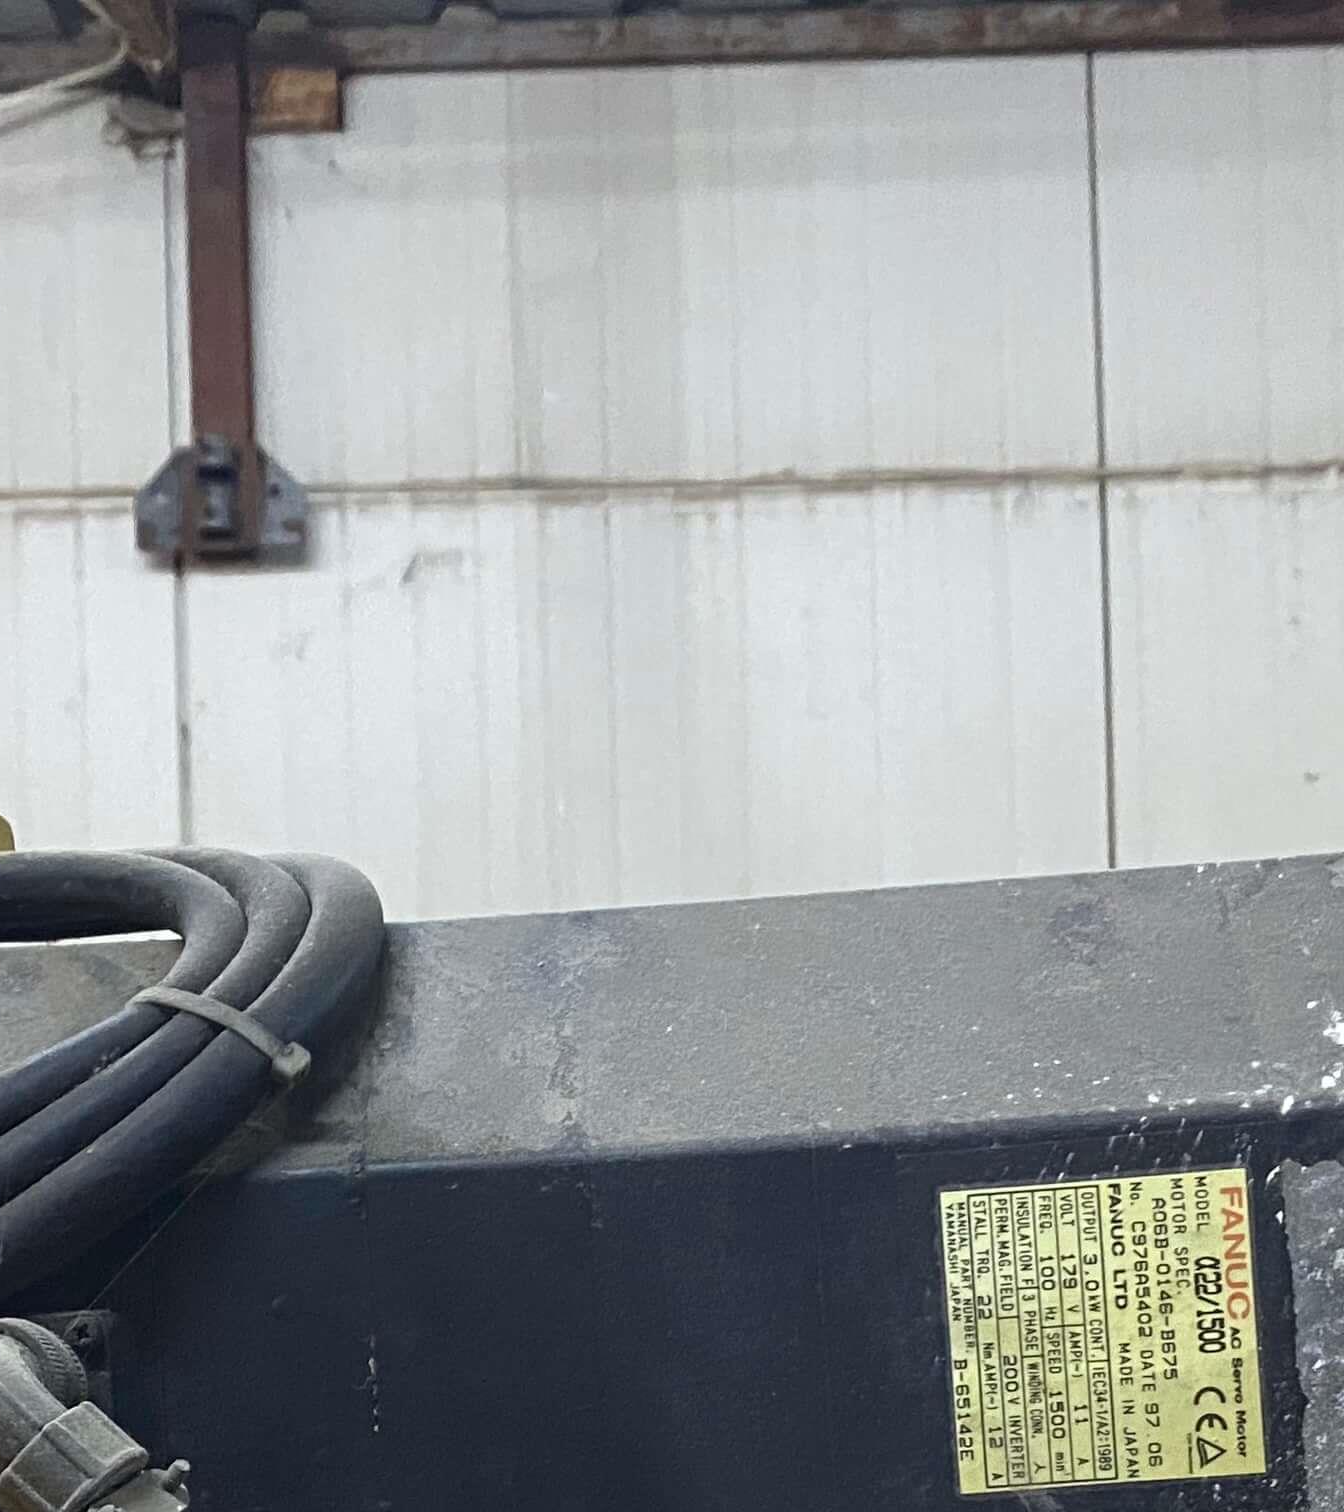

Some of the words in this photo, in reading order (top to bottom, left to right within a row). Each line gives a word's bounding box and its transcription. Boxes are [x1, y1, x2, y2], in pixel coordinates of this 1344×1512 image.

[1060, 1195, 1074, 1226] VOLT
[1130, 1182, 1142, 1206] No.
[1171, 1178, 1187, 1234] MOTOR
[1195, 1176, 1210, 1232] MODEL
[957, 1202, 968, 1250] MANUAL
[973, 1200, 988, 1239] STALL
[1016, 1197, 1032, 1271] INSULATION
[1038, 1196, 1052, 1234] FREQ.
[1081, 1192, 1096, 1242] OUTPUT
[1108, 1184, 1125, 1256] FANUC
[946, 1204, 958, 1274] YAMANASHI
[1220, 1187, 1251, 1320] FANUC
[960, 1260, 972, 1290] PART
[976, 1249, 990, 1278] TRQ.
[1040, 1256, 1056, 1290] 100
[1061, 1254, 1077, 1289] 179
[1084, 1254, 1100, 1291] 3.0
[1132, 1221, 1152, 1337] C976A5402
[1174, 1247, 1190, 1295] SPEC.
[950, 1284, 961, 1321] JAPAN
[977, 1295, 992, 1320] 22
[1068, 1304, 1080, 1313] V
[1088, 1296, 1100, 1312] kW
[1113, 1269, 1128, 1309] LTD
[1152, 1198, 1178, 1380] A06B-0146-B675
[1024, 1311, 1039, 1350] PHASE
[1045, 1306, 1056, 1321] Hz
[982, 1342, 994, 1359] Nm
[1047, 1333, 1062, 1374] SPEED
[1089, 1319, 1104, 1357] CONT.
[1230, 1327, 1242, 1349] AC
[1004, 1355, 1019, 1392] 200
[1028, 1362, 1043, 1404] WINDING
[1118, 1343, 1133, 1386] MADE
[1140, 1350, 1156, 1392] DATE
[1232, 1358, 1243, 1404] Servo
[954, 1360, 974, 1461] B-65142E
[1030, 1409, 1043, 1438] CONN.
[1049, 1391, 1066, 1439] 1500
[1074, 1404, 1089, 1425] 11
[1122, 1400, 1135, 1414] IN
[988, 1427, 1004, 1448] 12
[1009, 1416, 1025, 1478] INVERTER
[1123, 1427, 1140, 1478] JAPAN
[1236, 1410, 1247, 1458] Motor
